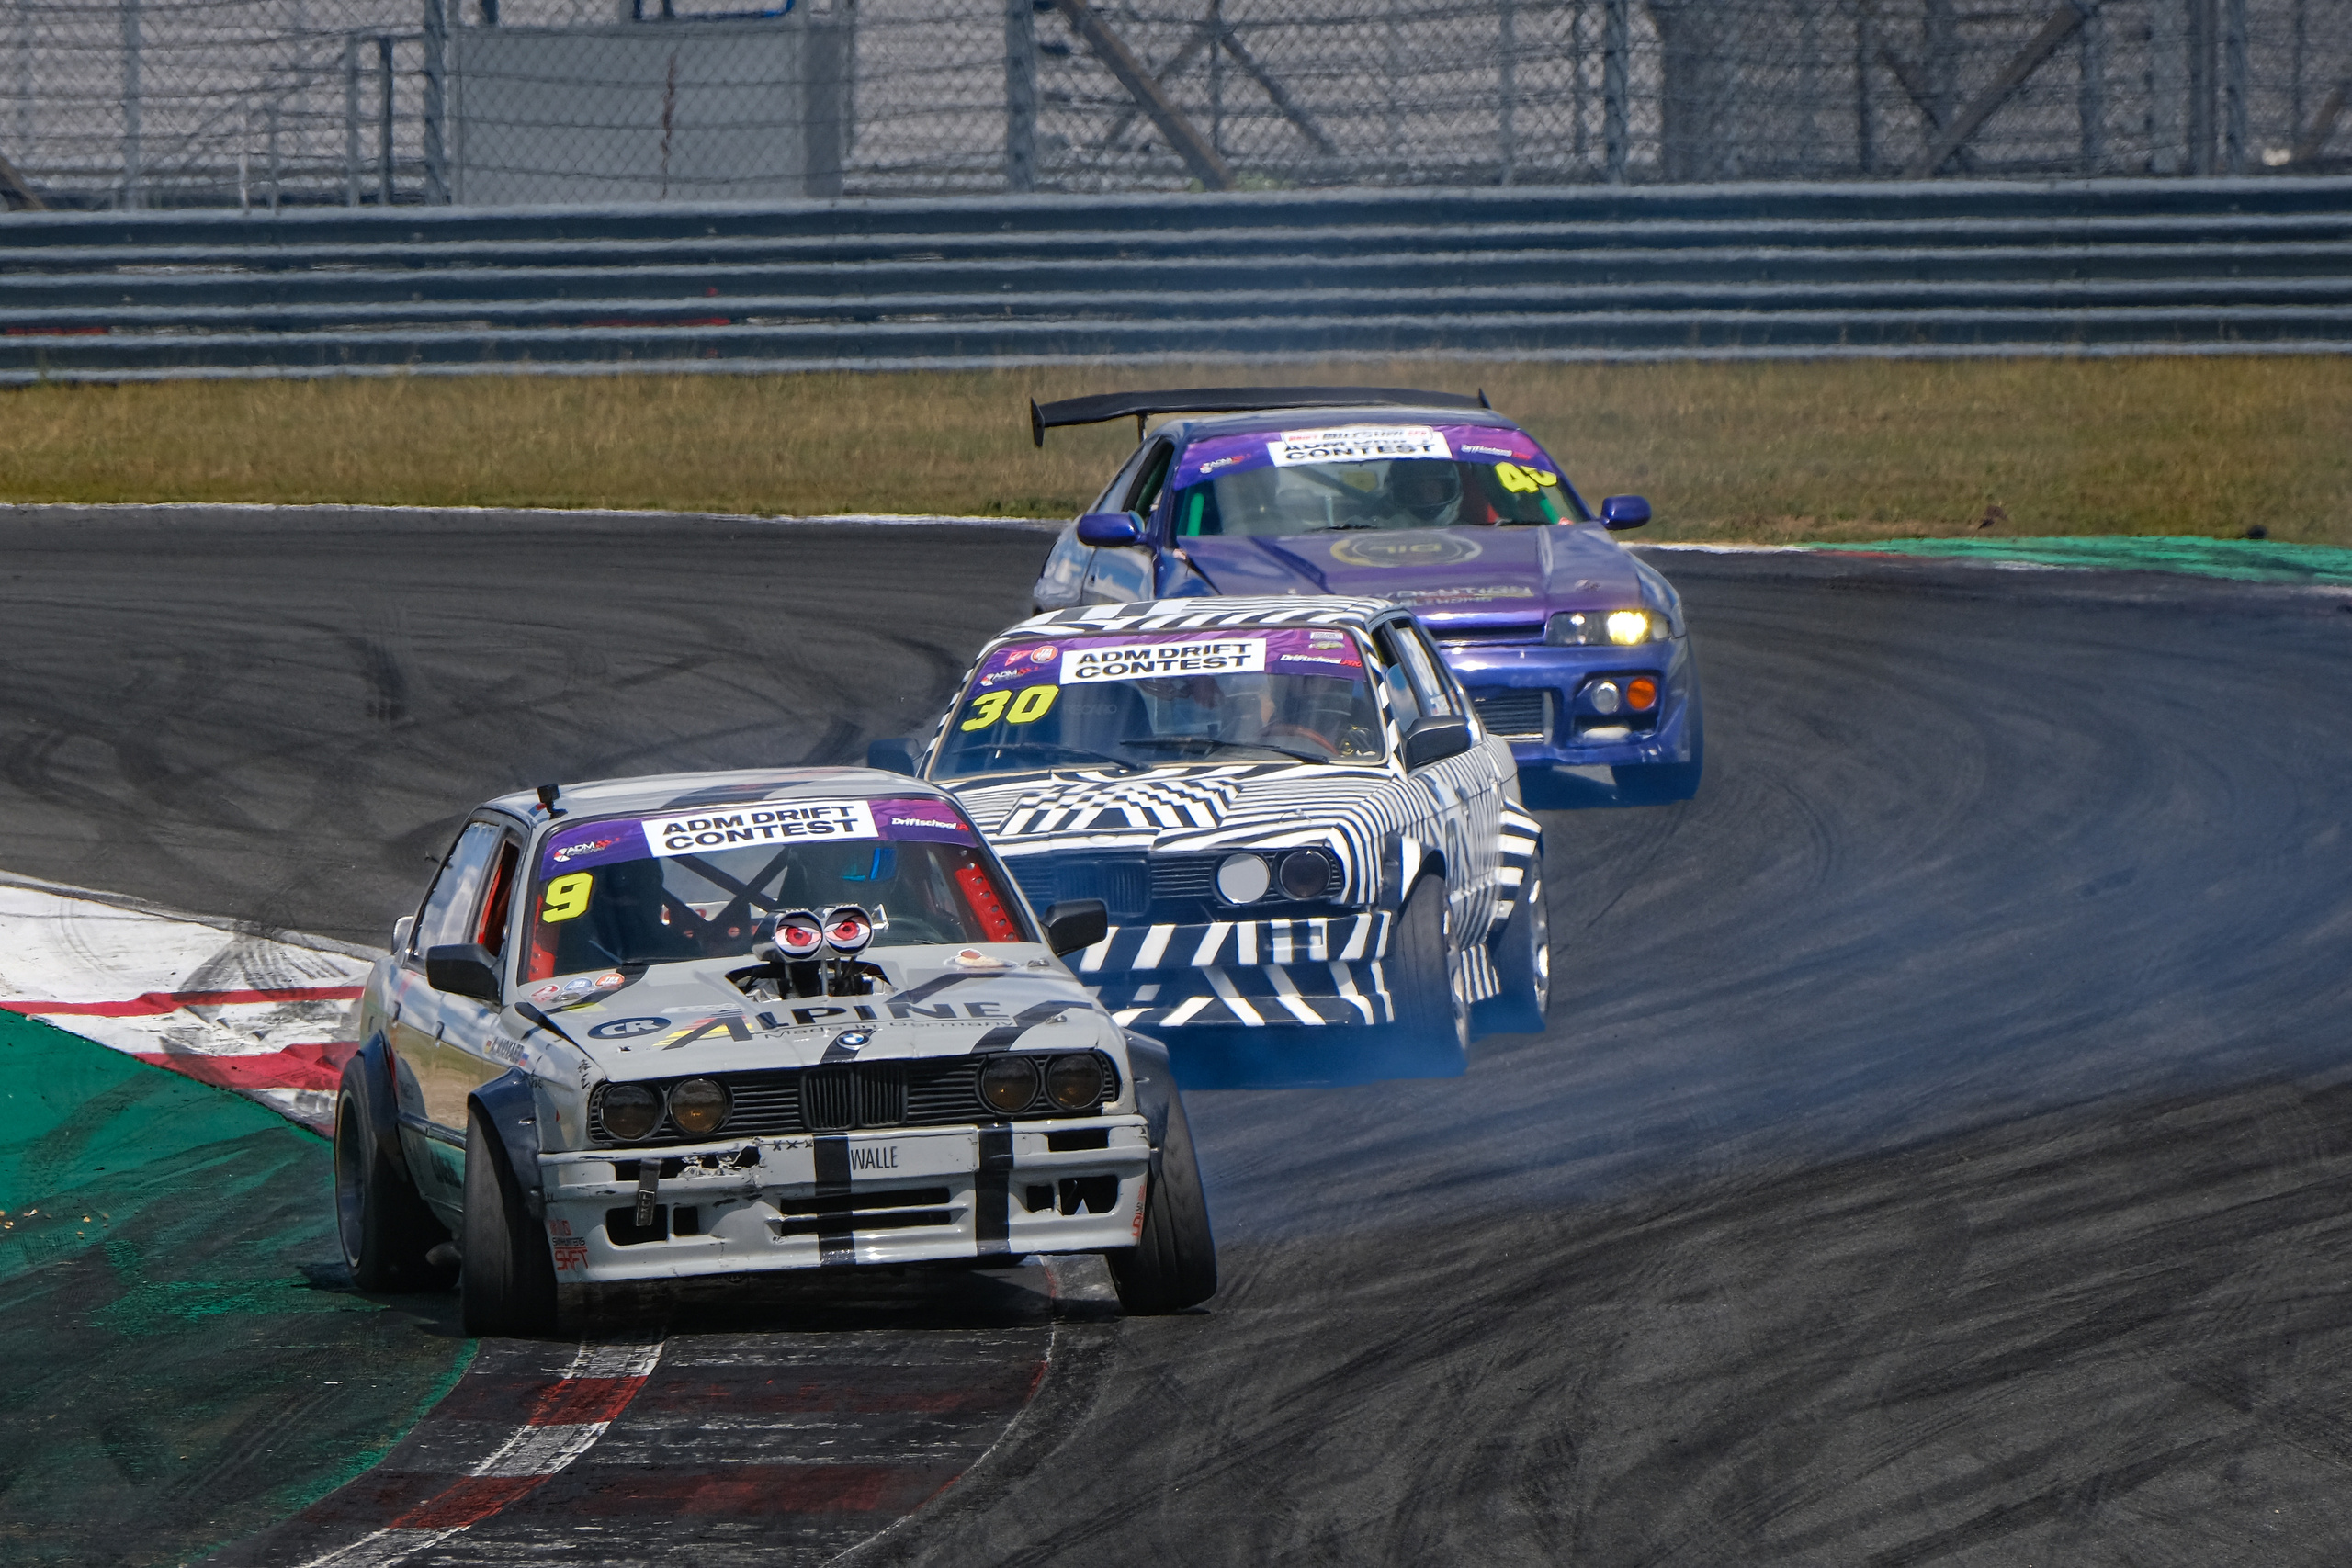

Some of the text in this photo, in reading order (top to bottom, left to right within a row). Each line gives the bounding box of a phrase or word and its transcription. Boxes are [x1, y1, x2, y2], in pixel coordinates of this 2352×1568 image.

[1285, 445, 1433, 460] CONTEST
[1075, 656, 1245, 679] CONTEST
[1079, 644, 1248, 665] ADM DRIFT
[961, 684, 1059, 732] 30
[663, 806, 854, 836] ADM DRIFT
[567, 841, 595, 853] ADM
[663, 818, 859, 851] CONTEST
[543, 873, 594, 923] 9
[600, 1019, 661, 1036] CR
[662, 1001, 1010, 1050] ALPINE
[850, 1145, 899, 1171] WALLE
